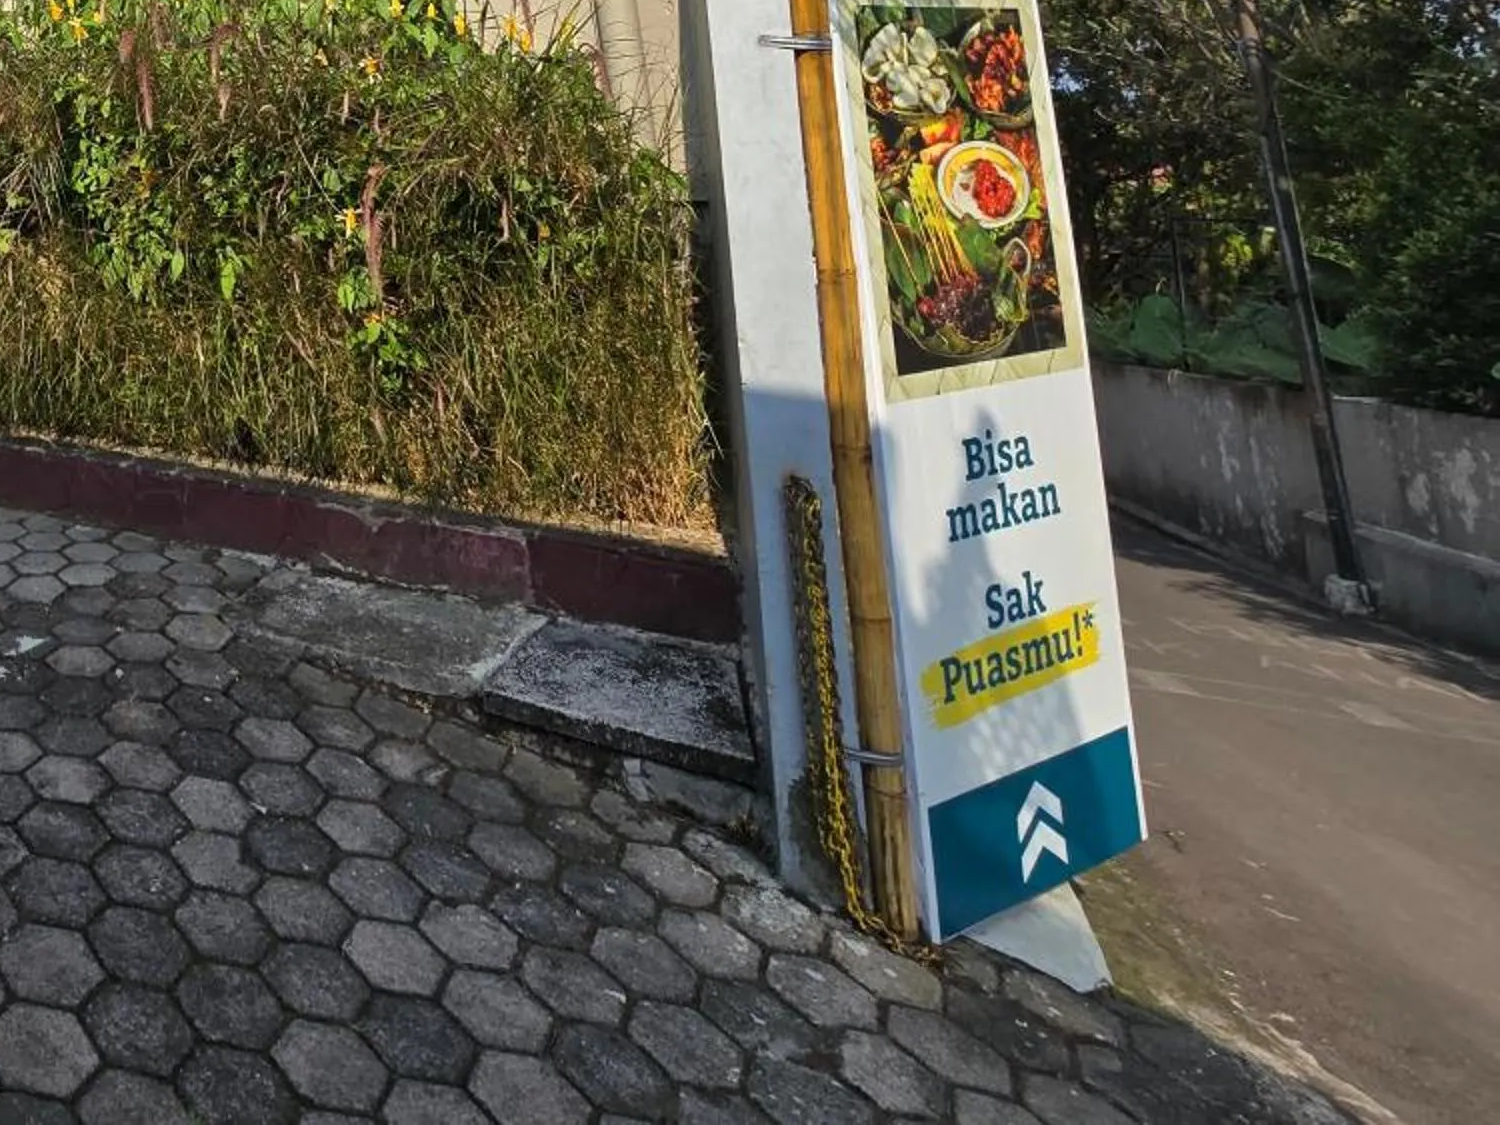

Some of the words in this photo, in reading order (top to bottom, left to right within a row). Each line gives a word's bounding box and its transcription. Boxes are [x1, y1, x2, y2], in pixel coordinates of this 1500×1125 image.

[961, 428, 1034, 482] Bisa
[945, 481, 1061, 543] makan
[984, 570, 1047, 630] Sak
